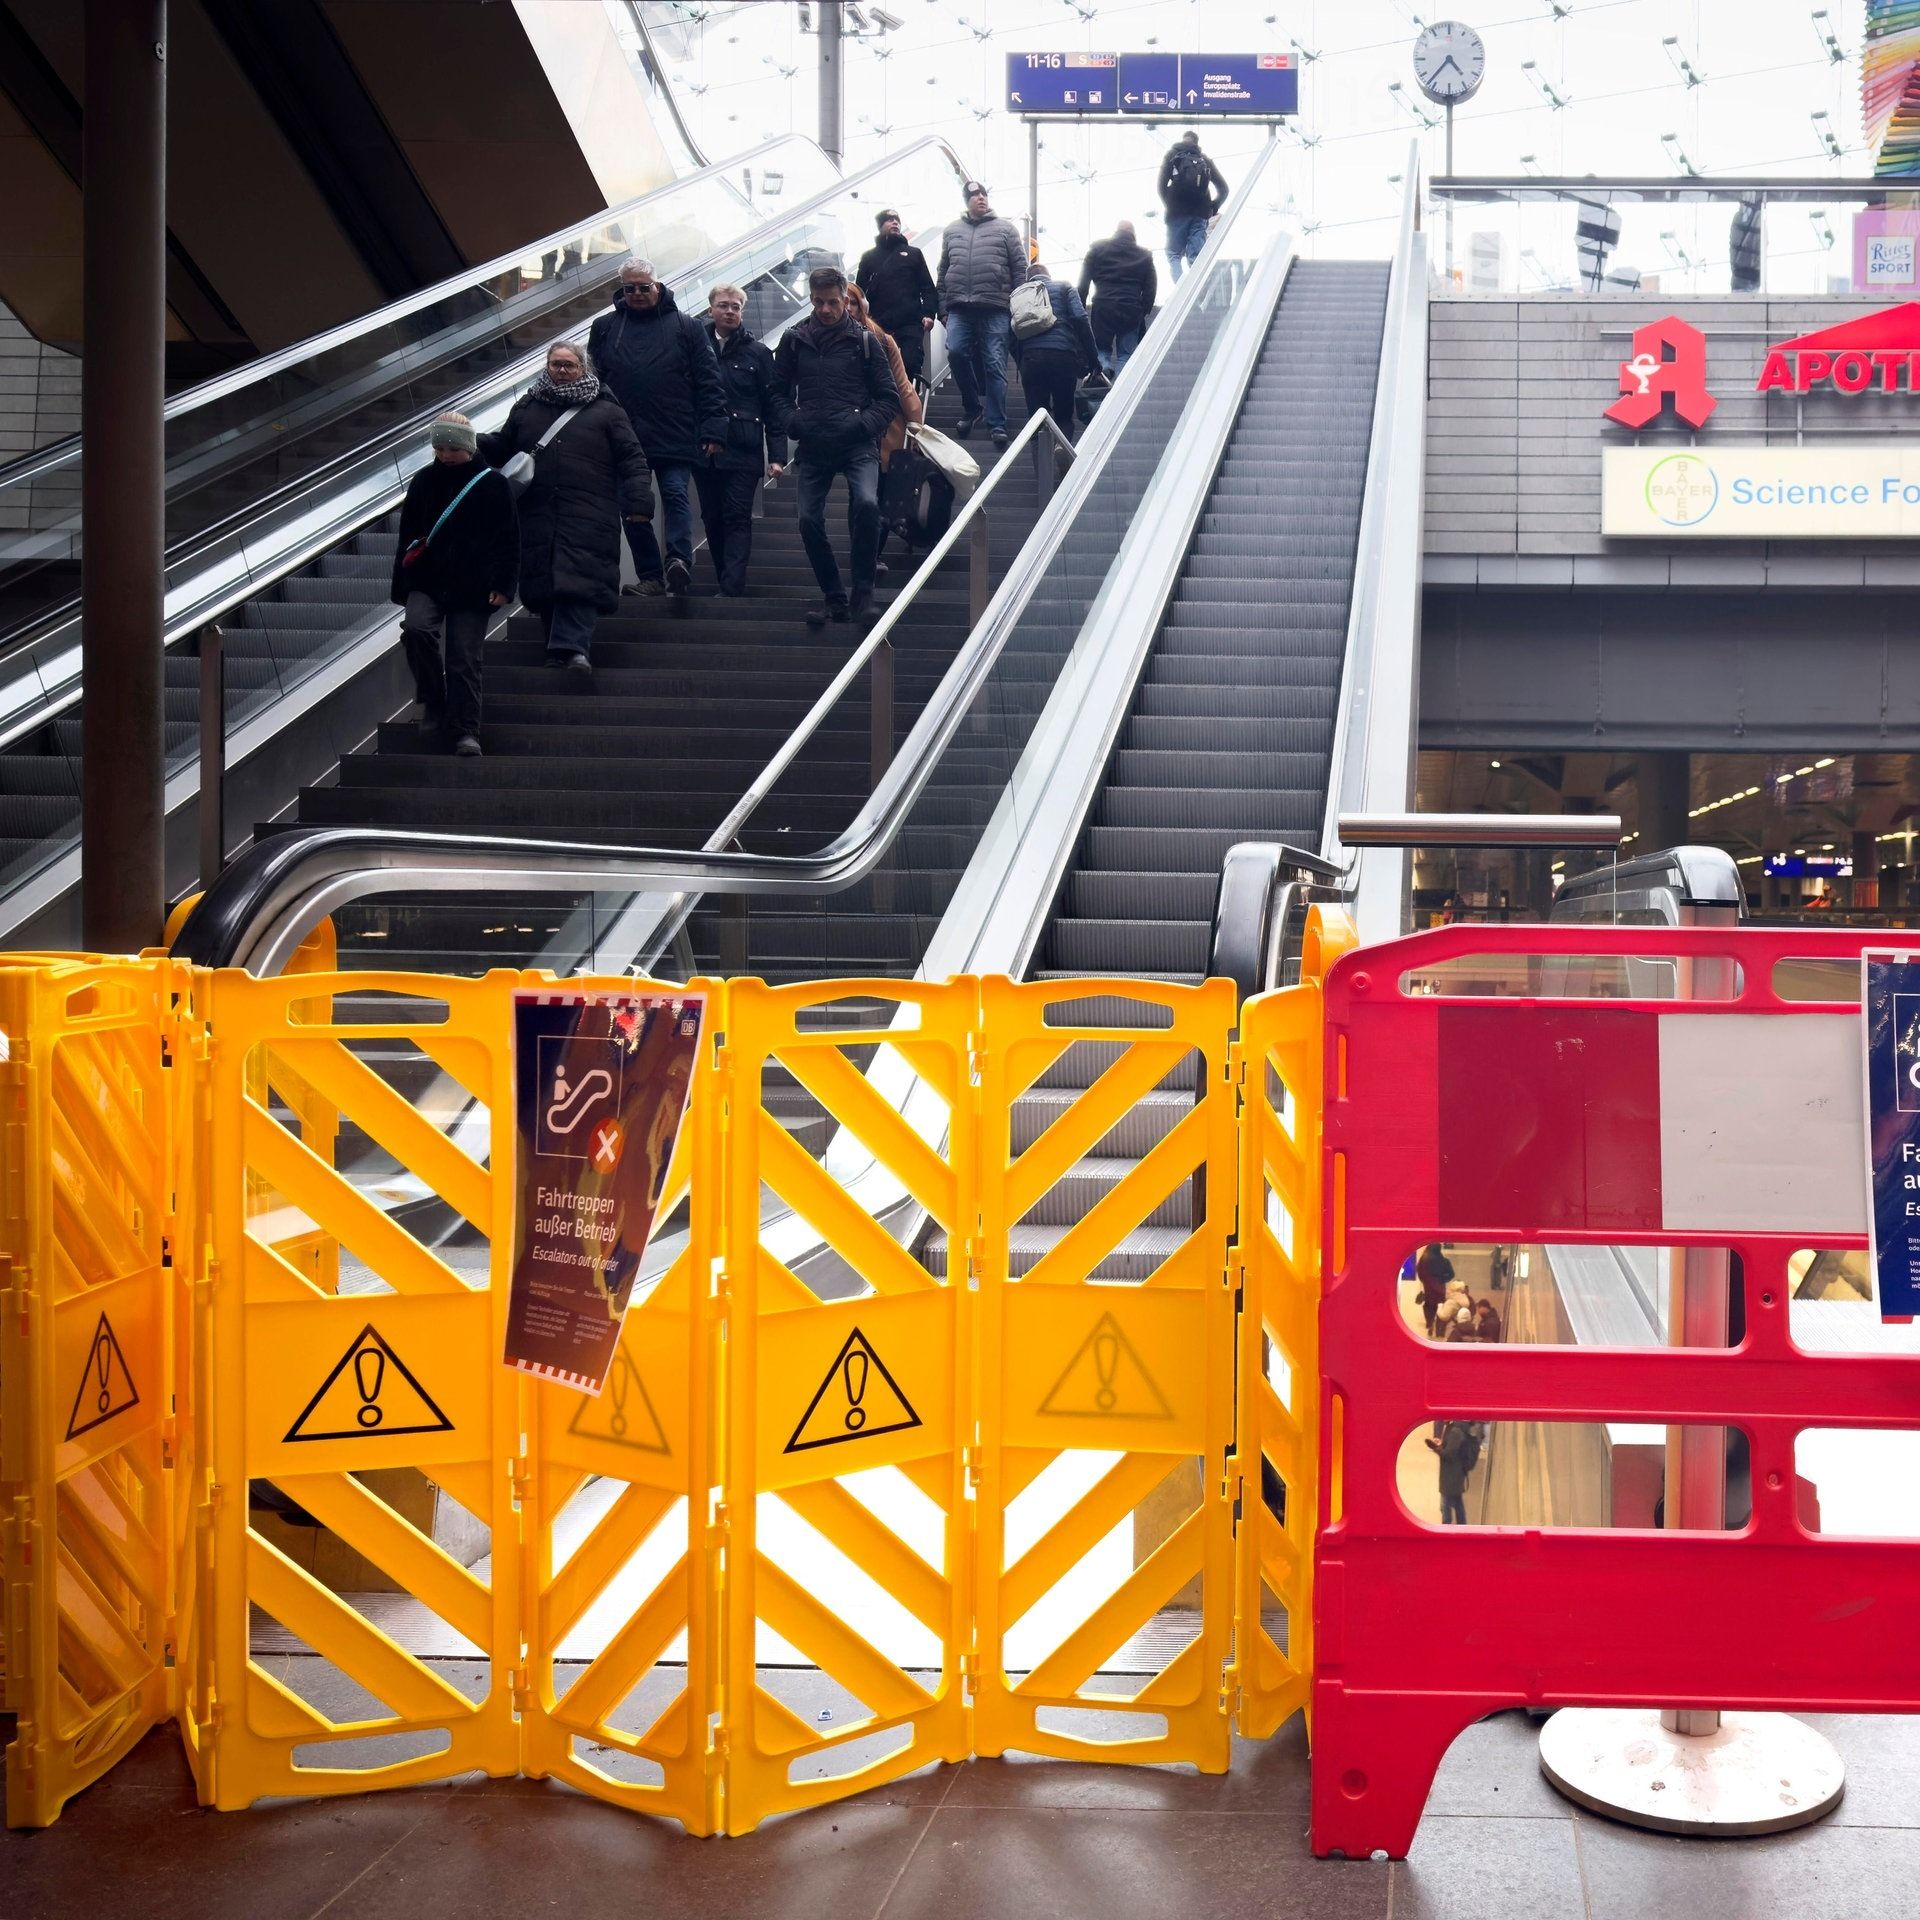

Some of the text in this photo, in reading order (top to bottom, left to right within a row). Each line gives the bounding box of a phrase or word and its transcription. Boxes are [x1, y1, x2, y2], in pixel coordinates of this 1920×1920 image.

[1025, 53, 1061, 69] 11-16
[1078, 54, 1088, 65] S
[1203, 73, 1232, 82] Ausgang
[1203, 82, 1241, 91] Europaplatz
[1203, 91, 1251, 99] Invalidenstraße
[1870, 263, 1911, 273] SPORT
[1755, 351, 1920, 393] APOT
[1652, 485, 1713, 496] BAYER
[1732, 478, 1869, 504] Science
[536, 1186, 615, 1216] Fahrtreppen
[534, 1214, 617, 1243] außer Betrieb
[532, 1245, 577, 1266] Escalators
[577, 1255, 592, 1268] out
[600, 1256, 620, 1272] order
